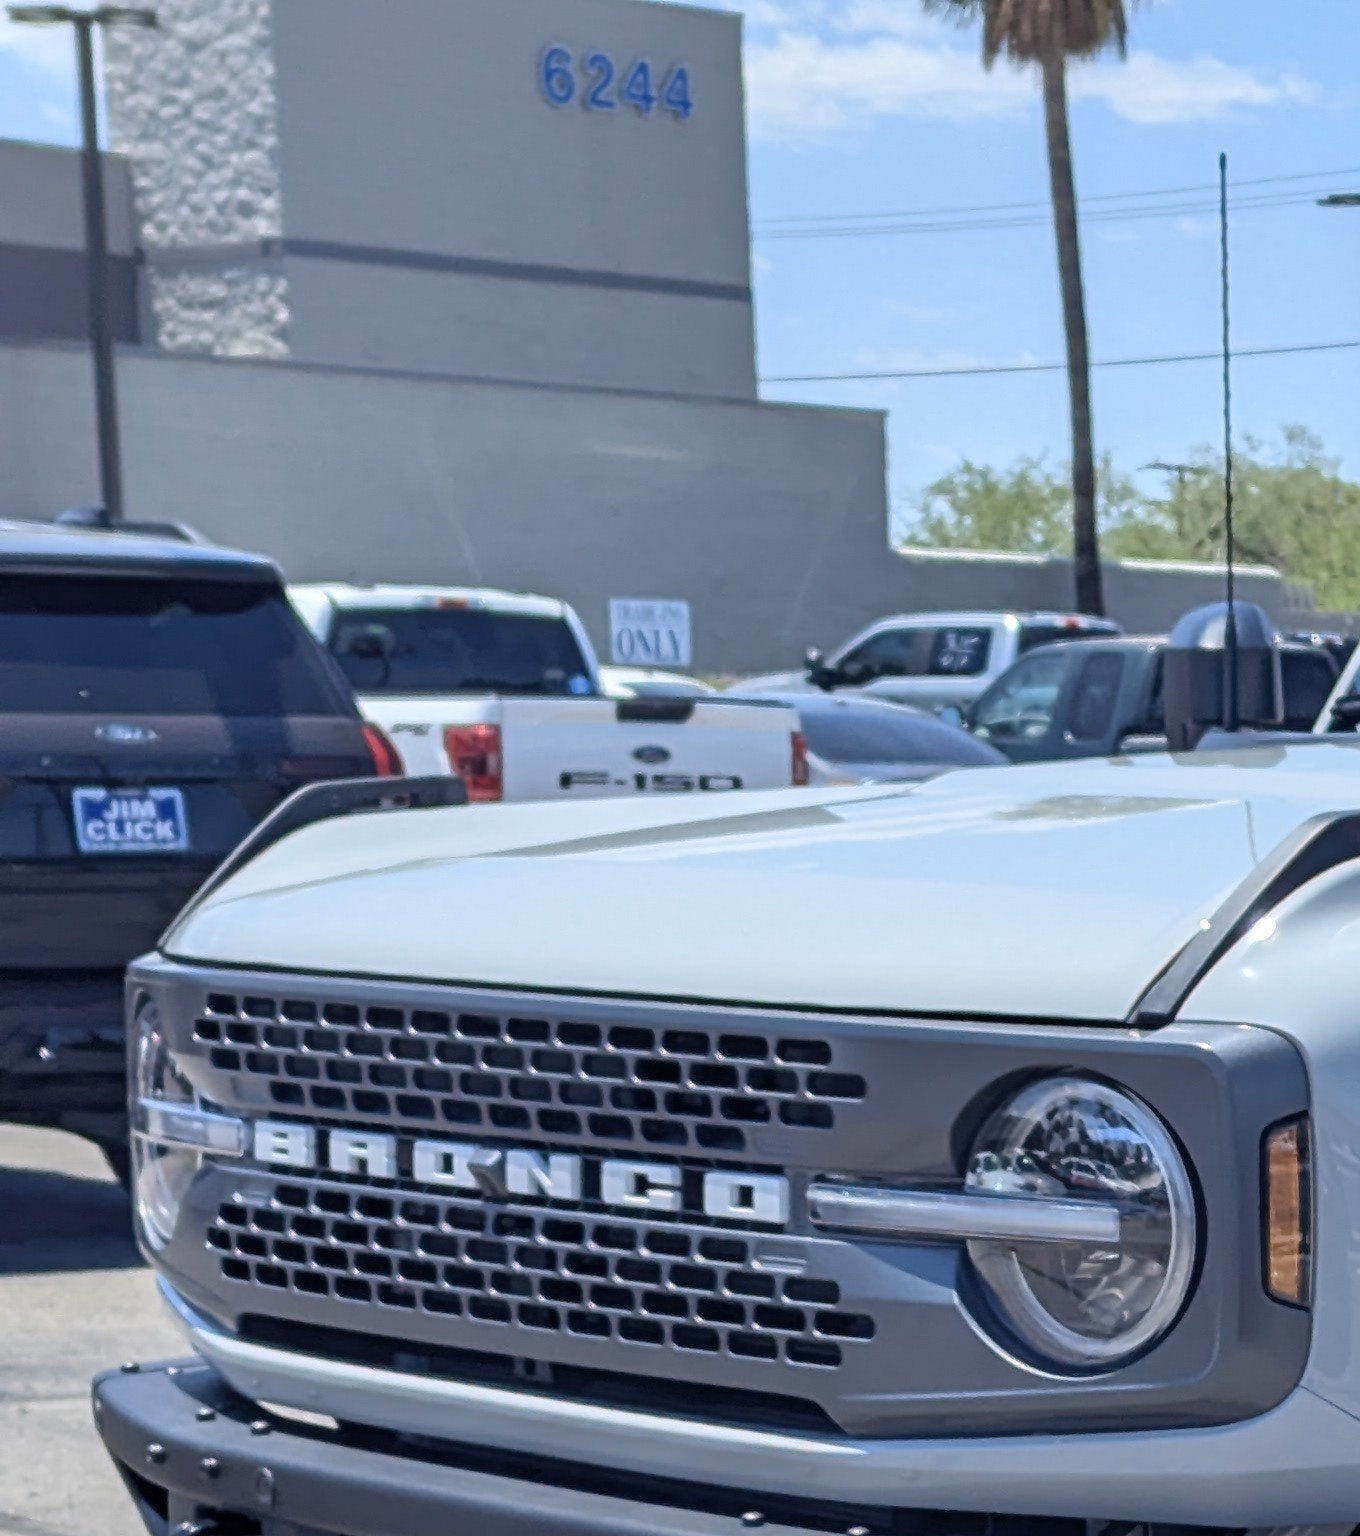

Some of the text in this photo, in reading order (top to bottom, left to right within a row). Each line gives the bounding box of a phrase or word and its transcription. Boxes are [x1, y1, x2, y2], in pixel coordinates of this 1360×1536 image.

[543, 47, 693, 120] 6244
[616, 628, 680, 662] ONLY
[559, 771, 744, 791] F-150
[102, 799, 156, 820] JIM
[86, 820, 175, 842] CLICK
[253, 1119, 790, 1225] BRONCO
